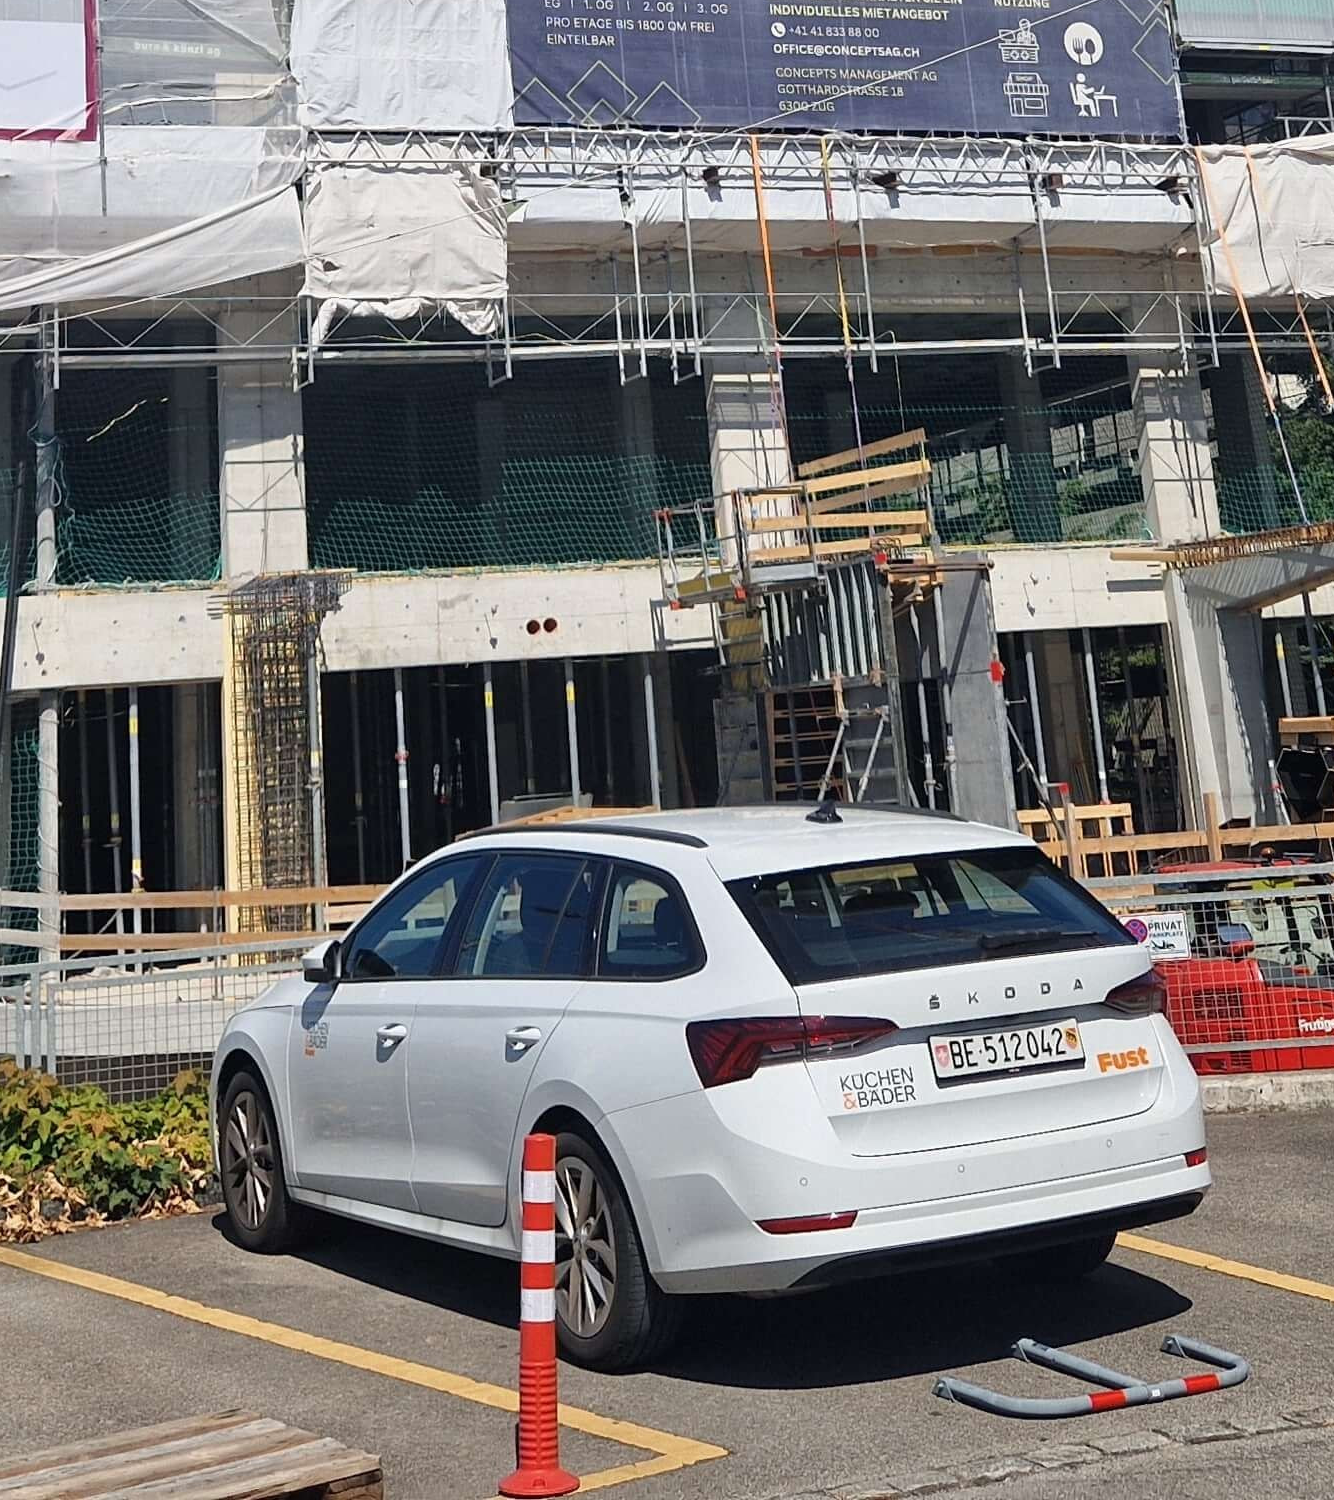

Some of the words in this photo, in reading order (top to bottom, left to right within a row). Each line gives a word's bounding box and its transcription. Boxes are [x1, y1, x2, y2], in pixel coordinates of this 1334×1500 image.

[596, 0, 614, 10] OG
[643, 2, 654, 12] 2.
[657, 2, 674, 13] OG
[697, 4, 707, 14] 3.
[710, 4, 728, 14] OG
[770, 4, 860, 18] INDIVIDUELLES
[862, 7, 949, 21] MIETANGEBOT
[546, 17, 570, 28] PRO
[573, 18, 612, 29] ETAGE
[616, 19, 634, 30] BIS
[637, 20, 665, 31] 1800
[691, 22, 715, 33] FREI
[789, 26, 808, 36] +41
[810, 27, 824, 37] 41
[826, 27, 845, 37] 833
[848, 28, 862, 37] 88
[865, 28, 880, 38] 00
[547, 34, 615, 46] EINTEILBAR
[773, 43, 920, 57] OFFICE@CONCEPTSAG.CH
[775, 68, 837, 79] CONCEPTS
[840, 69, 919, 81] MANAGEMENT
[922, 71, 937, 81] AG
[777, 84, 888, 96] GOTTHARDSTRASSE
[779, 101, 809, 111] 6300
[811, 102, 835, 112] ZUG
[1148, 921, 1183, 931] PRIVAT
[929, 978, 1083, 1010] ŠKODA
[1097, 1047, 1149, 1073] Fust
[839, 1067, 914, 1091] KÜCHEN
